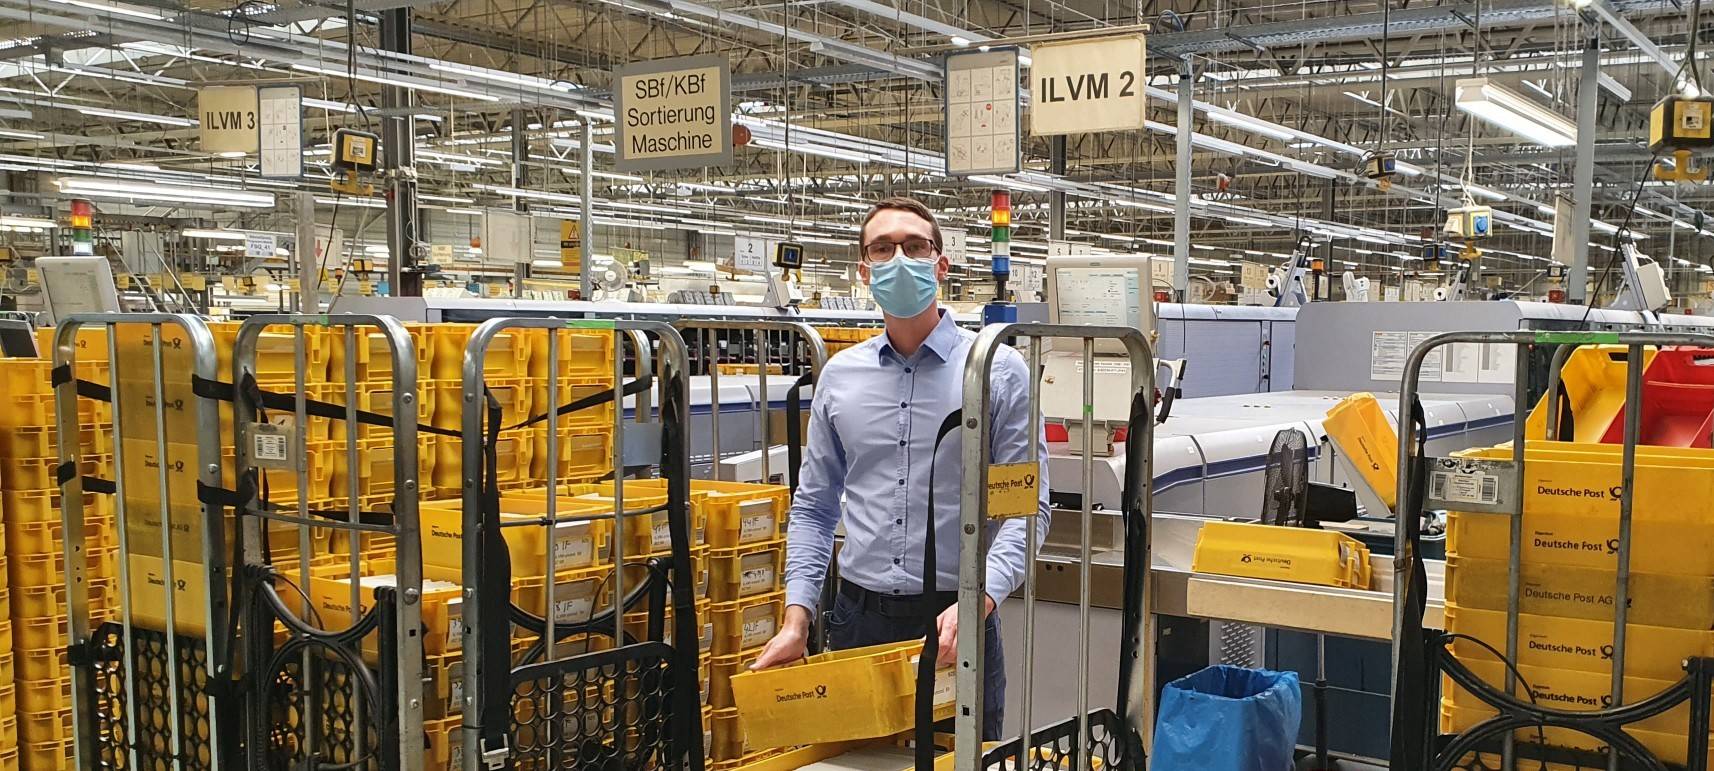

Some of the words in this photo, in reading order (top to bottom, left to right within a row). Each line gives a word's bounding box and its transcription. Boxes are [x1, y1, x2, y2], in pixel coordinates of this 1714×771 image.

[635, 73, 706, 99] SBf/KBf
[1041, 73, 1109, 103] ILVM
[1119, 70, 1135, 97] 2
[206, 111, 242, 130] ILVM
[247, 111, 255, 129] 3
[627, 105, 715, 127] Sortierung
[632, 131, 712, 154] Maschine
[747, 242, 753, 253] 2
[988, 480, 1010, 490] eutsche
[1010, 480, 1023, 488] Post
[1537, 486, 1582, 497] Deutsche
[1584, 489, 1605, 498] Post
[1534, 538, 1579, 550] Deutsche
[1582, 541, 1603, 552] Post
[1525, 588, 1571, 601] Deutsche
[1573, 592, 1594, 604] Post
[1597, 596, 1614, 605] AG
[1528, 641, 1573, 654] Deutsche
[1575, 646, 1596, 657] Post
[776, 693, 801, 703] Deutsche
[802, 690, 814, 699] Post
[1532, 690, 1575, 703] Deutsche
[1576, 696, 1598, 706] Post
